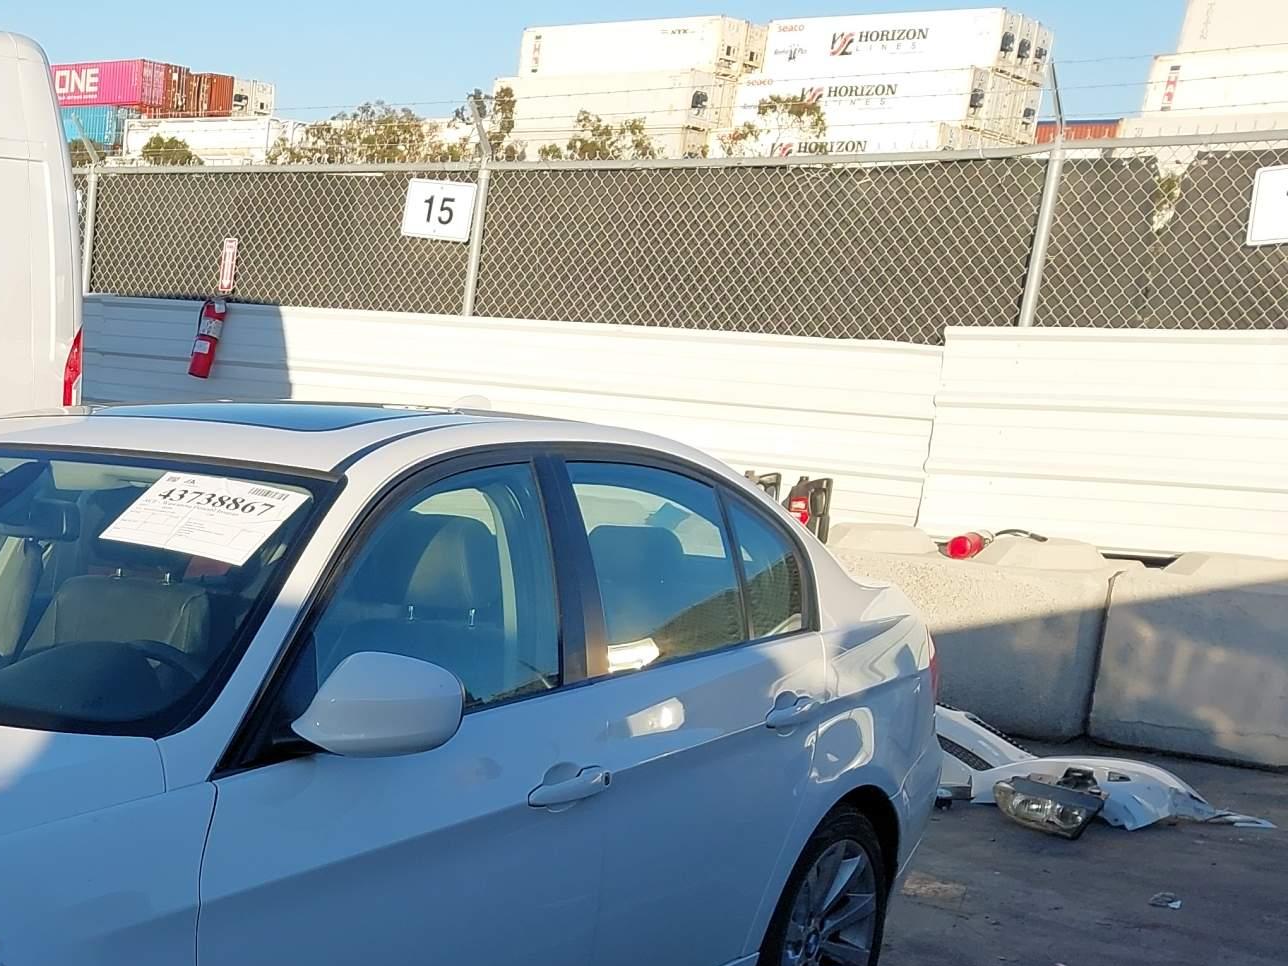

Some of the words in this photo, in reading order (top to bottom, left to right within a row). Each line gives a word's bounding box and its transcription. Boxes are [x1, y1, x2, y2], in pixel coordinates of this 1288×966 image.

[777, 24, 805, 32] seaco
[858, 28, 930, 43] HORIZON
[856, 42, 917, 52] LINES
[55, 68, 99, 94] ONE
[827, 83, 899, 97] HORIZON
[824, 97, 886, 106] LINES
[797, 140, 868, 154] HORIZON
[423, 195, 456, 225] 15
[158, 487, 275, 516] 43738867
